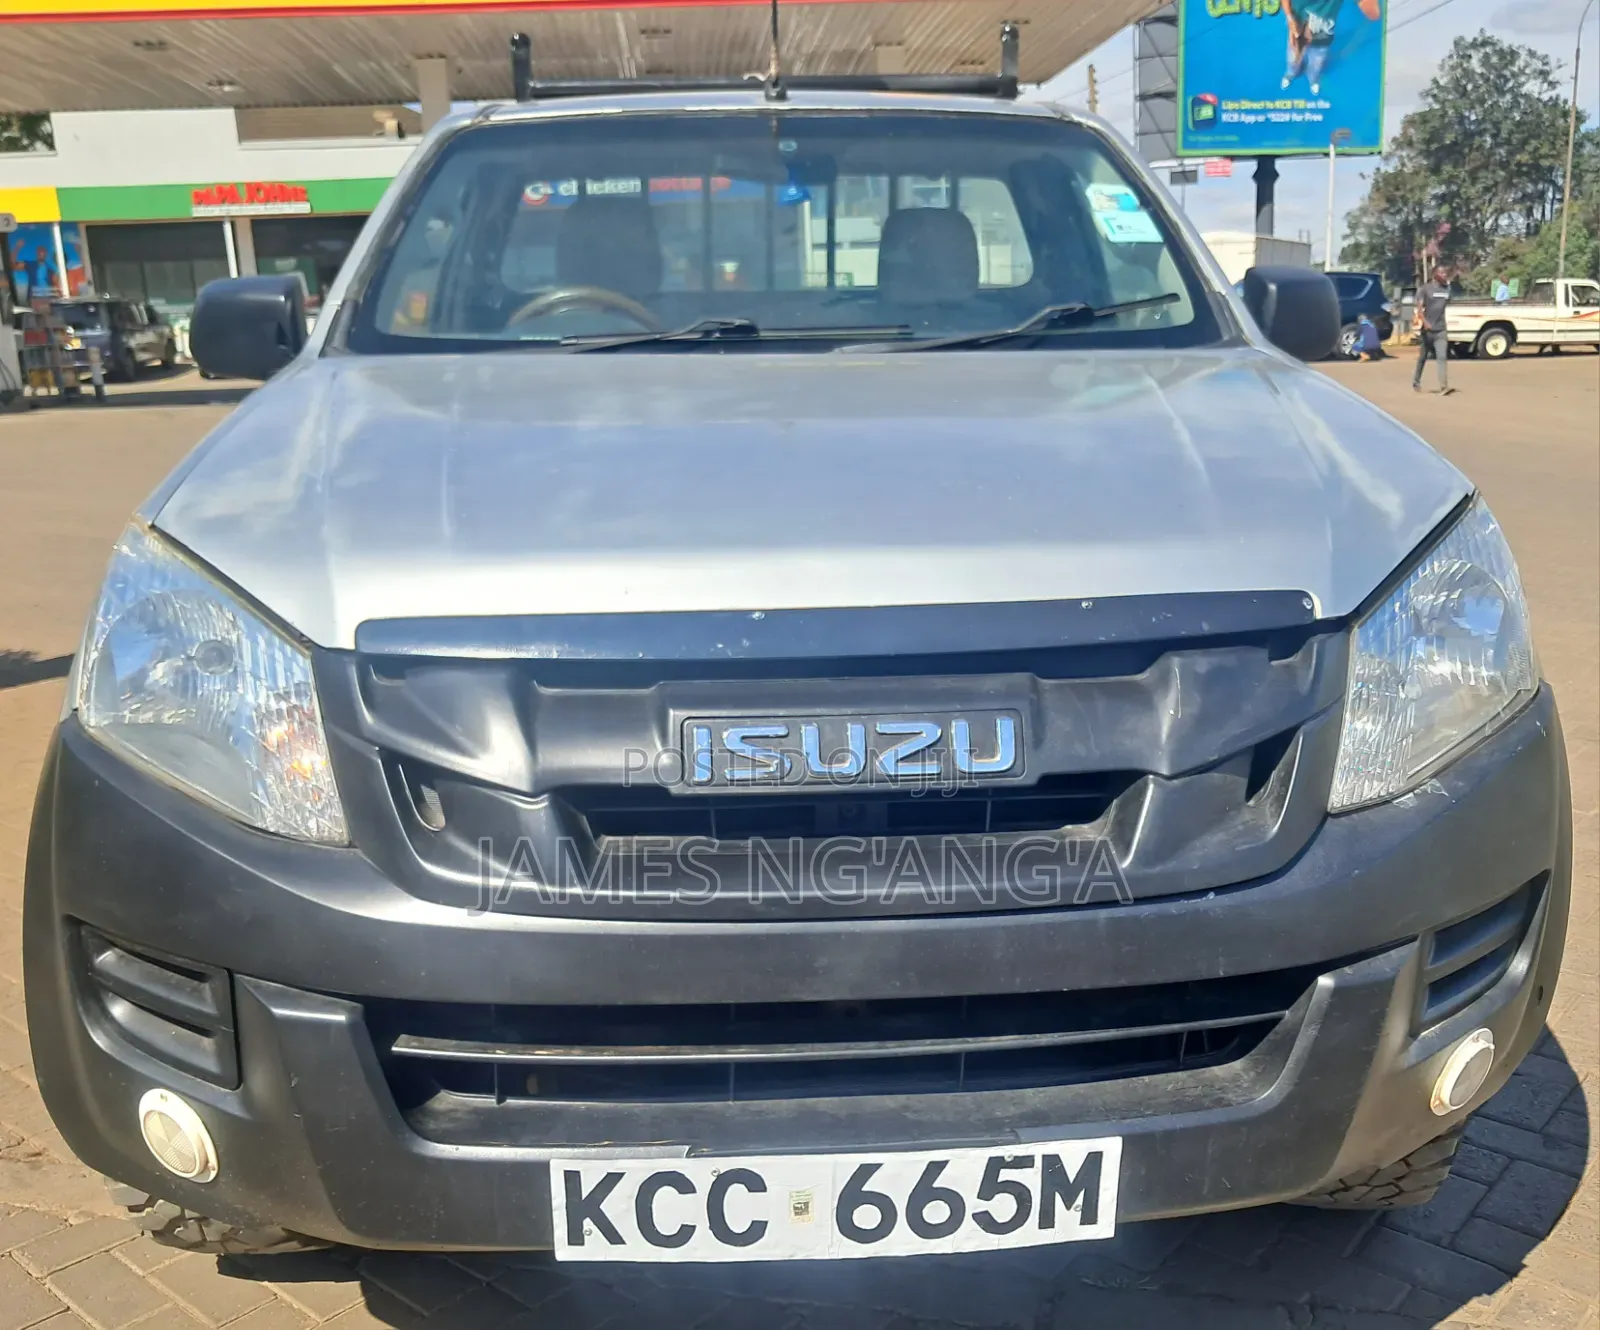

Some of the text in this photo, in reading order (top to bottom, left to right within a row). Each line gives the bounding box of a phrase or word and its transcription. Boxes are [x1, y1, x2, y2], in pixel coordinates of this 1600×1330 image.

[1222, 112, 1239, 122] KCB
[692, 716, 1016, 782] ISUZU
[563, 1150, 1106, 1249] KCC 665M
